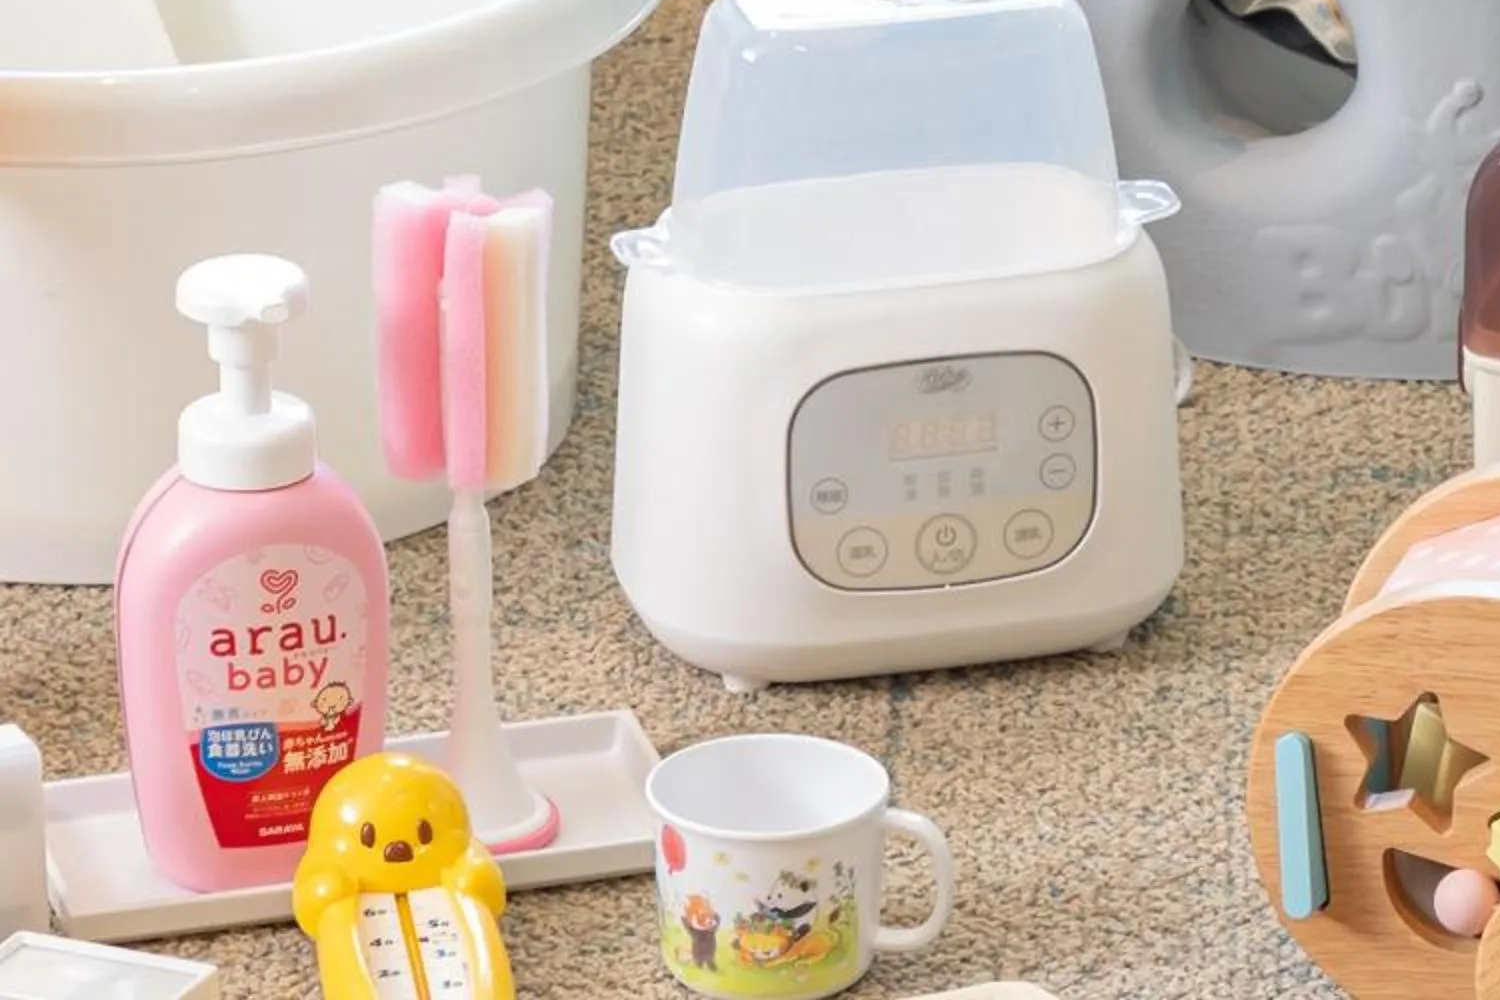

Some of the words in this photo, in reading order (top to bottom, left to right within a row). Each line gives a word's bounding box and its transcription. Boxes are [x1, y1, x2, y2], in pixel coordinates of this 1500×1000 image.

[226, 656, 329, 691] baby
[283, 742, 348, 774] 無添加
